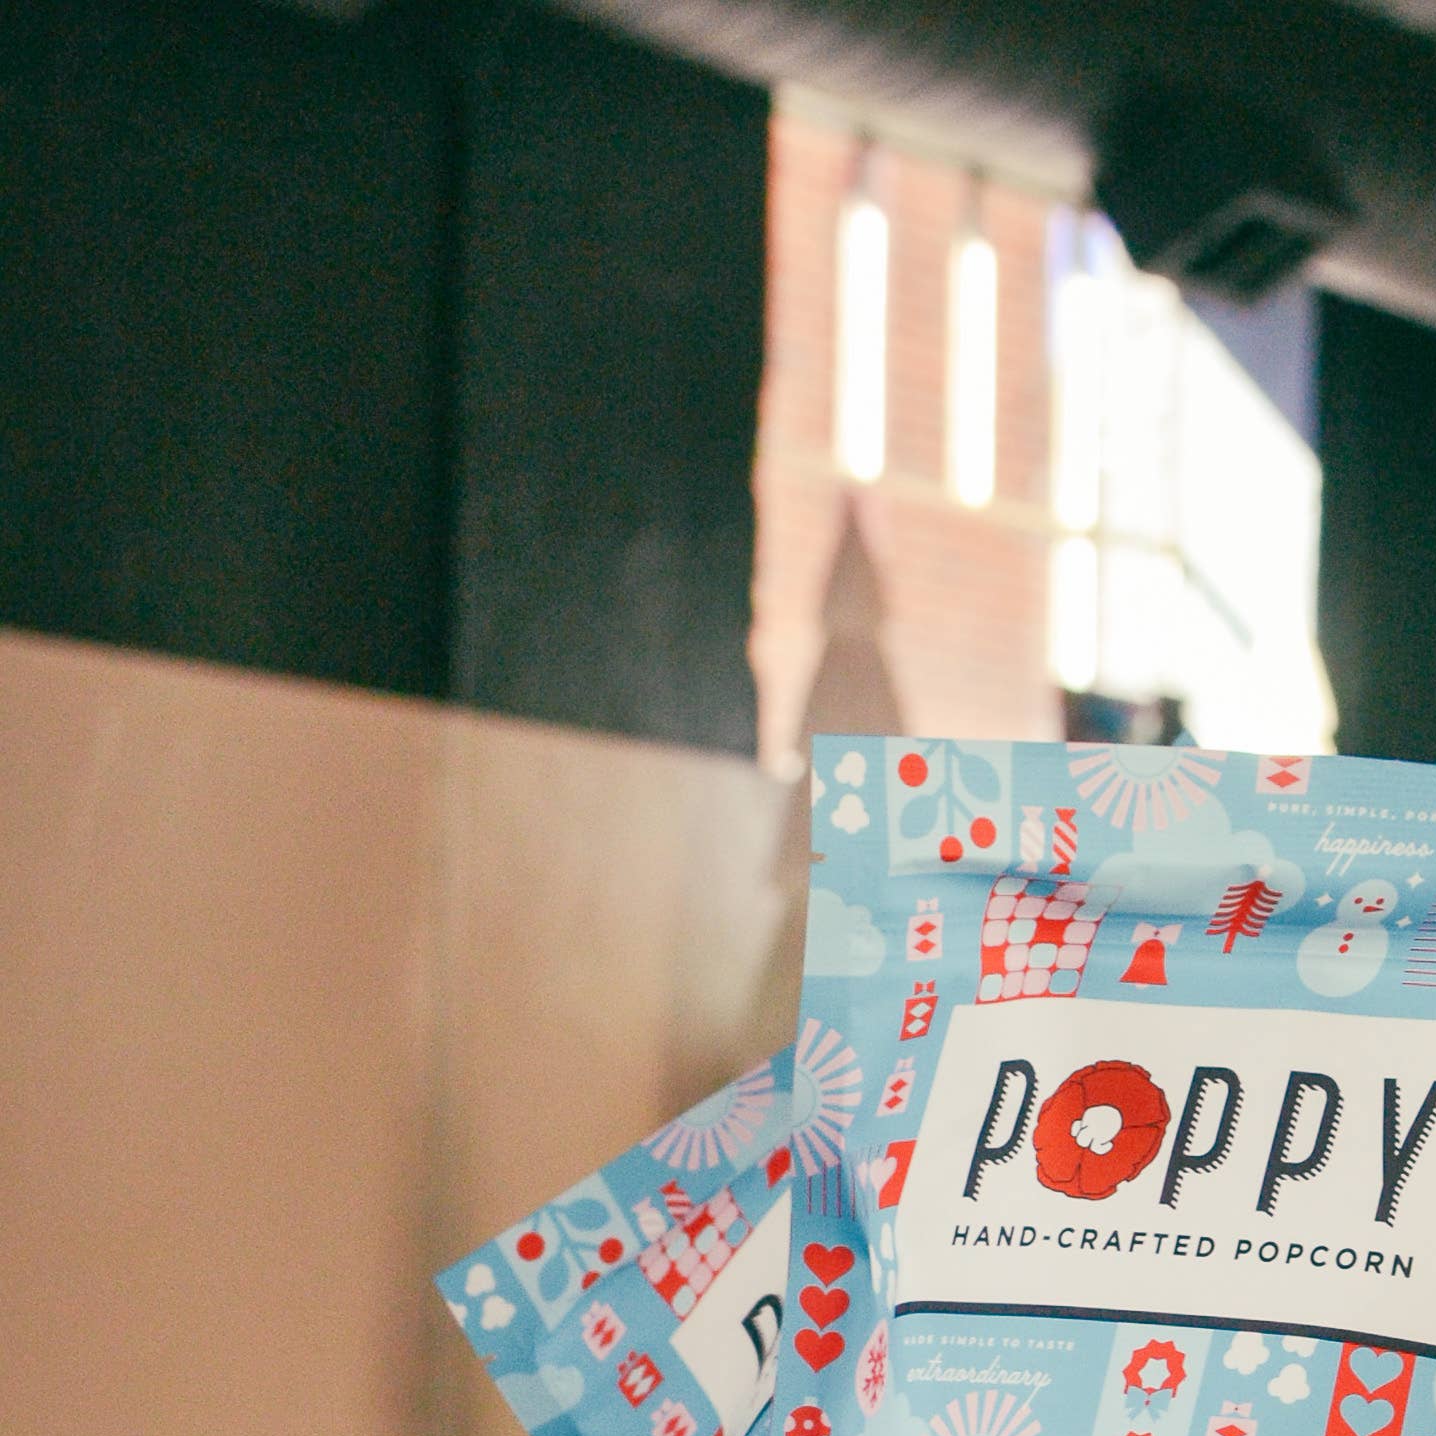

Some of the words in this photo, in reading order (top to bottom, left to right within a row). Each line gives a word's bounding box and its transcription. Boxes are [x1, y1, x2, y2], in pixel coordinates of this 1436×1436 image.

[1314, 821, 1435, 877] happiness
[952, 1225, 1217, 1258] HAND-CRAFTED
[1234, 1238, 1415, 1279] POPCORN
[941, 1335, 996, 1348] SIMPLE
[1002, 1337, 1022, 1349] TO
[1027, 1338, 1076, 1352] TASTE
[906, 1352, 1053, 1409] extraordinary
